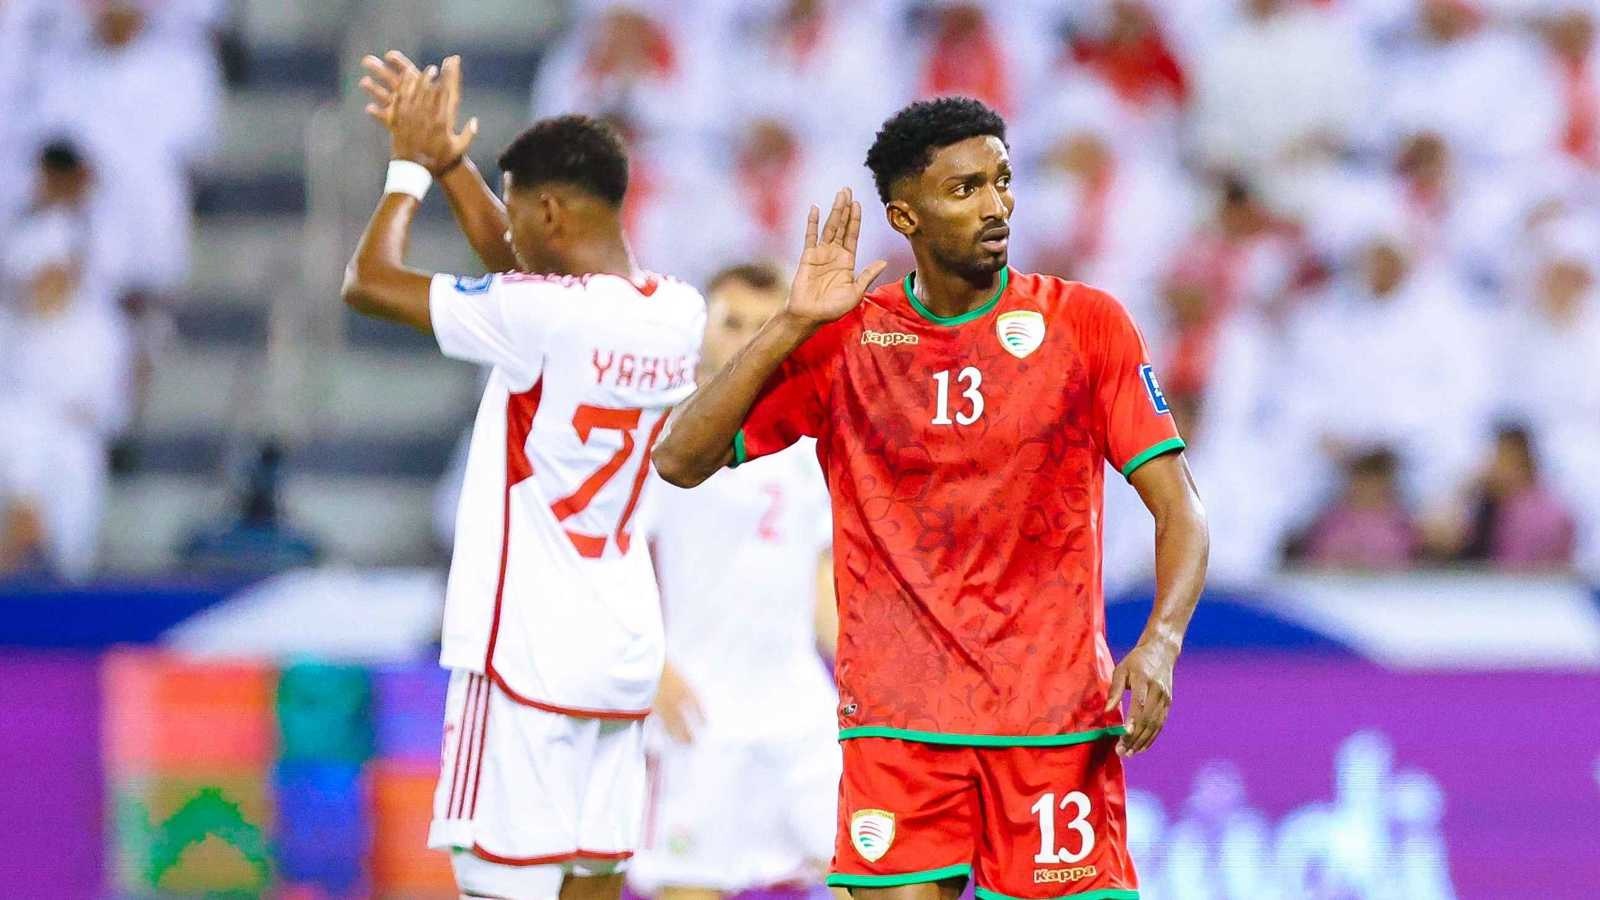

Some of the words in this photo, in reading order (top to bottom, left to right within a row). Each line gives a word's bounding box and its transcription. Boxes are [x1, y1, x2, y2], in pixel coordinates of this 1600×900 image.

[931, 366, 985, 426] 13
[757, 482, 785, 542] 2
[1031, 790, 1095, 865] 13
[1034, 865, 1097, 884] Kappa
